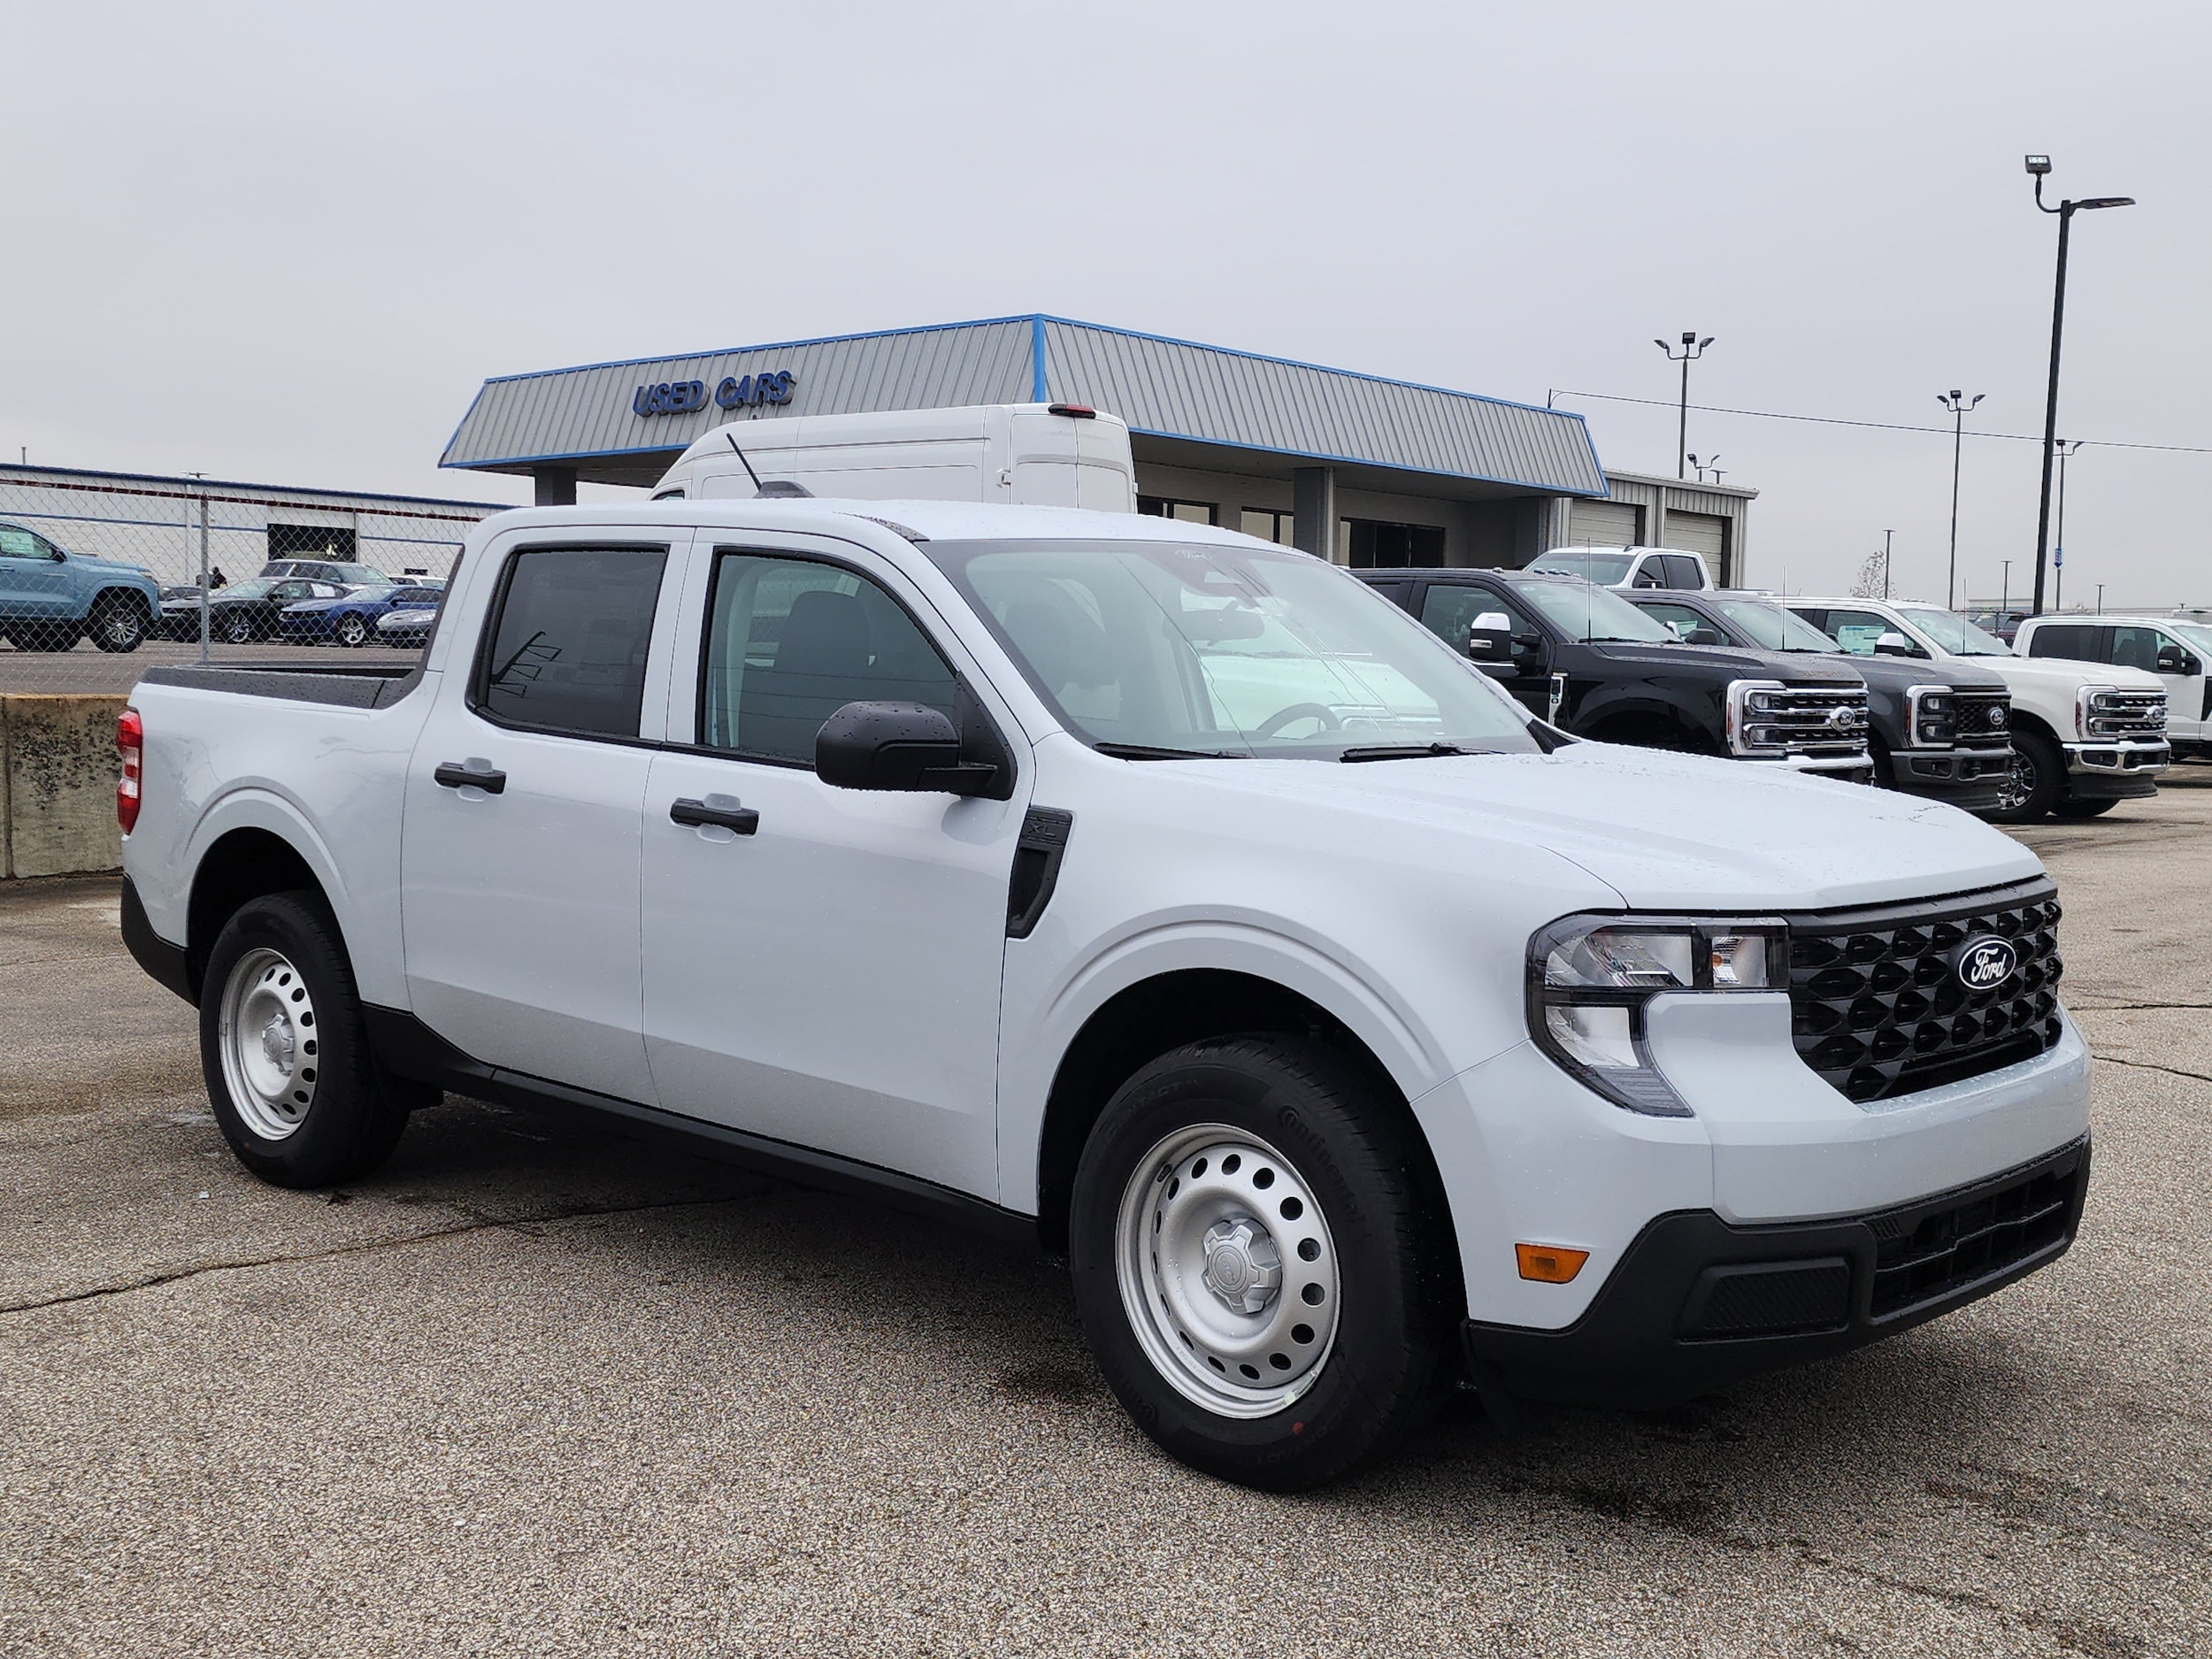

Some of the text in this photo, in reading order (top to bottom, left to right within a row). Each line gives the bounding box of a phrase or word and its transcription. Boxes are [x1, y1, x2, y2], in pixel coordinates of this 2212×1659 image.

[633, 370, 795, 417] USED CARS
[1027, 822, 1056, 838] XL
[1970, 948, 2007, 983] Ford
